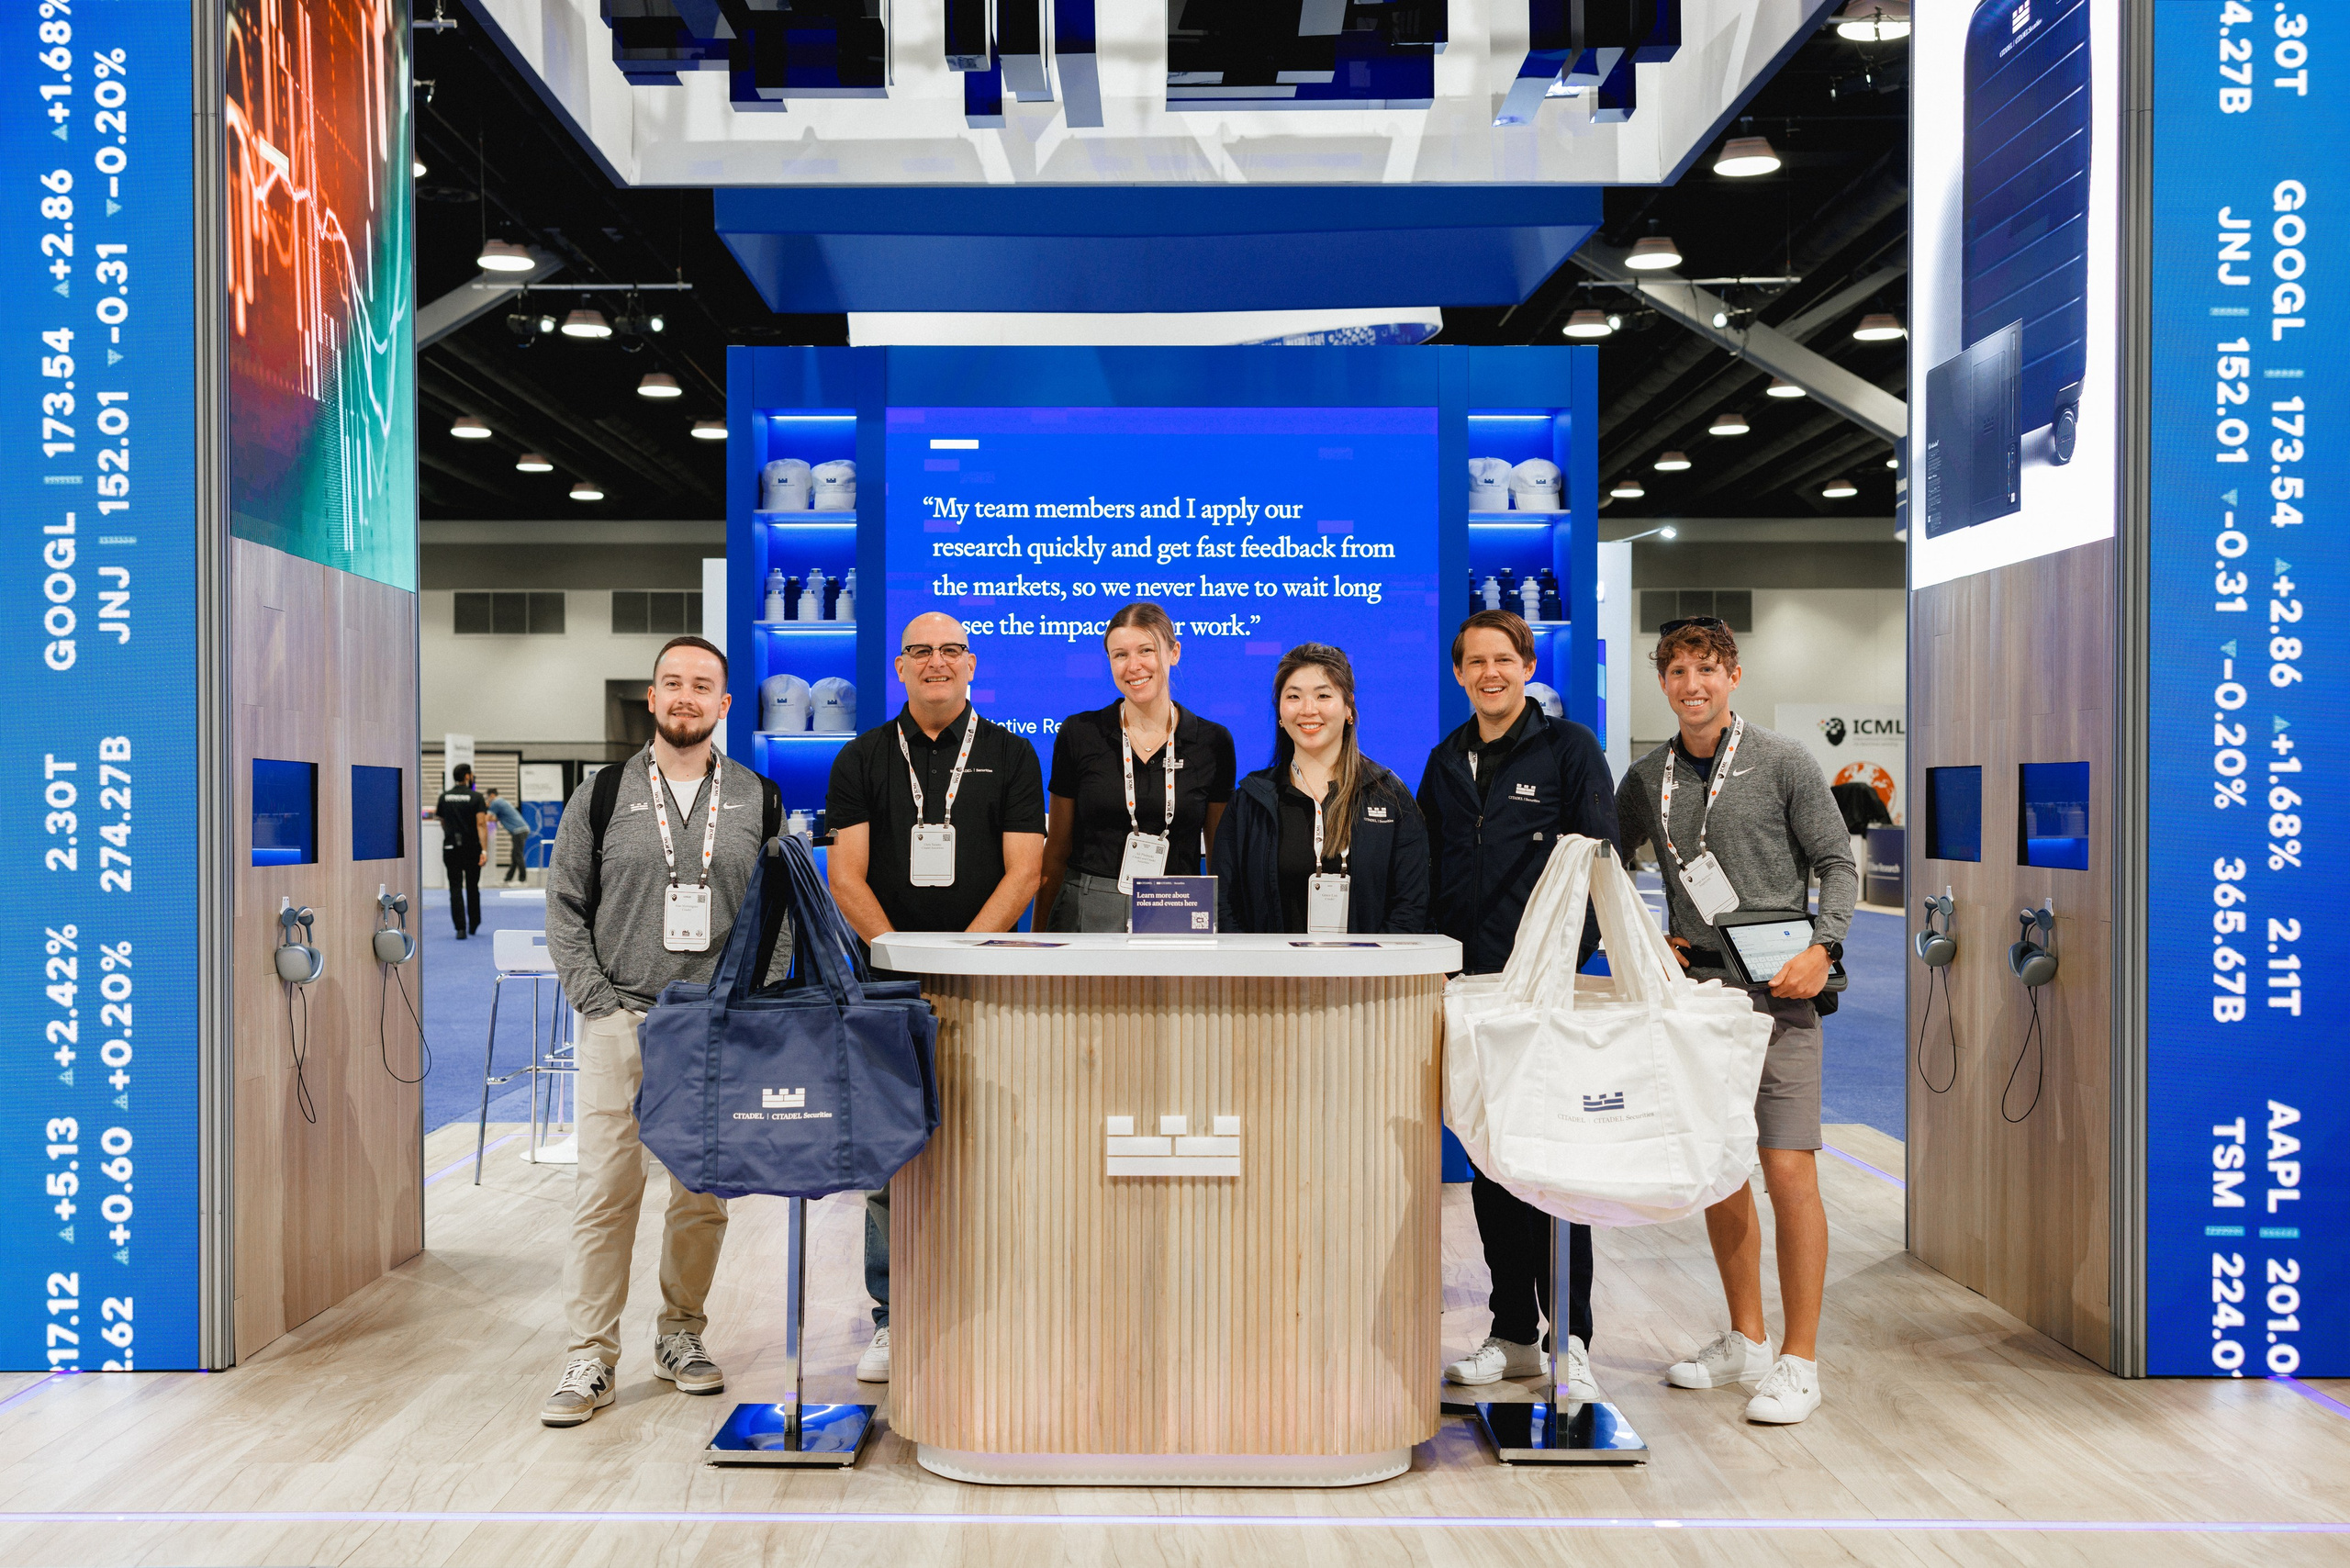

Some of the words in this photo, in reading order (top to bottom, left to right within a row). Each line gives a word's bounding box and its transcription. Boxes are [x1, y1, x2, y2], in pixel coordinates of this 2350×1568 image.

[39, 0, 72, 123] +1.68%
[2220, 0, 2253, 114] 4.27B
[40, 170, 73, 280] +2.86
[2218, 207, 2251, 286] JNJ
[2272, 179, 2306, 342] GOOGL
[42, 328, 74, 457] 173.54
[2216, 337, 2250, 463] 152.01
[97, 392, 129, 515] 152.01
[2271, 396, 2304, 528] 173.54
[932, 534, 1022, 557] research
[1026, 534, 1106, 565] quickly
[1111, 534, 1153, 558] and
[1156, 541, 1192, 566] get
[1196, 534, 1237, 558] fast
[1240, 534, 1336, 558] feedback
[1340, 534, 1396, 558] from
[974, 501, 1030, 518] team
[1035, 496, 1136, 519] members
[1140, 496, 1181, 519] and
[1186, 498, 1196, 519] I
[1201, 496, 1260, 526] apply
[1264, 504, 1304, 519] our
[43, 512, 75, 671] GOOGL
[98, 566, 130, 644] JNJ
[932, 573, 968, 596] the
[972, 573, 1068, 601] markets,
[1072, 582, 1096, 597] so
[1101, 582, 1131, 597] we
[1136, 582, 1196, 597] never
[1199, 574, 1249, 597] have
[1254, 580, 1278, 597] to
[1281, 576, 1329, 598] wait
[1333, 574, 1382, 605] long
[962, 621, 994, 635] see
[998, 612, 1035, 635] the
[2269, 576, 2302, 688] +2.86
[1853, 720, 1905, 734] ICML
[45, 754, 77, 871] 2.30T
[99, 736, 131, 892] 274.27B
[2268, 734, 2301, 870] +1.68%
[46, 924, 78, 1067] +2.42%
[2213, 857, 2246, 1023] 365.67B
[2268, 918, 2300, 1016] 2.11T
[100, 941, 132, 1091] +0.20%
[46, 1117, 79, 1221] +5.13
[803, 1111, 833, 1119] Securities
[1557, 1113, 1586, 1124] CITADEL
[1594, 1115, 1624, 1124] CITADEL
[1626, 1112, 1654, 1121] Securities
[2212, 1117, 2245, 1207] TSM
[2267, 1100, 2300, 1213] AAPL
[101, 1127, 133, 1246] +0.60
[46, 1271, 79, 1371] 17.12
[2266, 1259, 2300, 1376] 201.0
